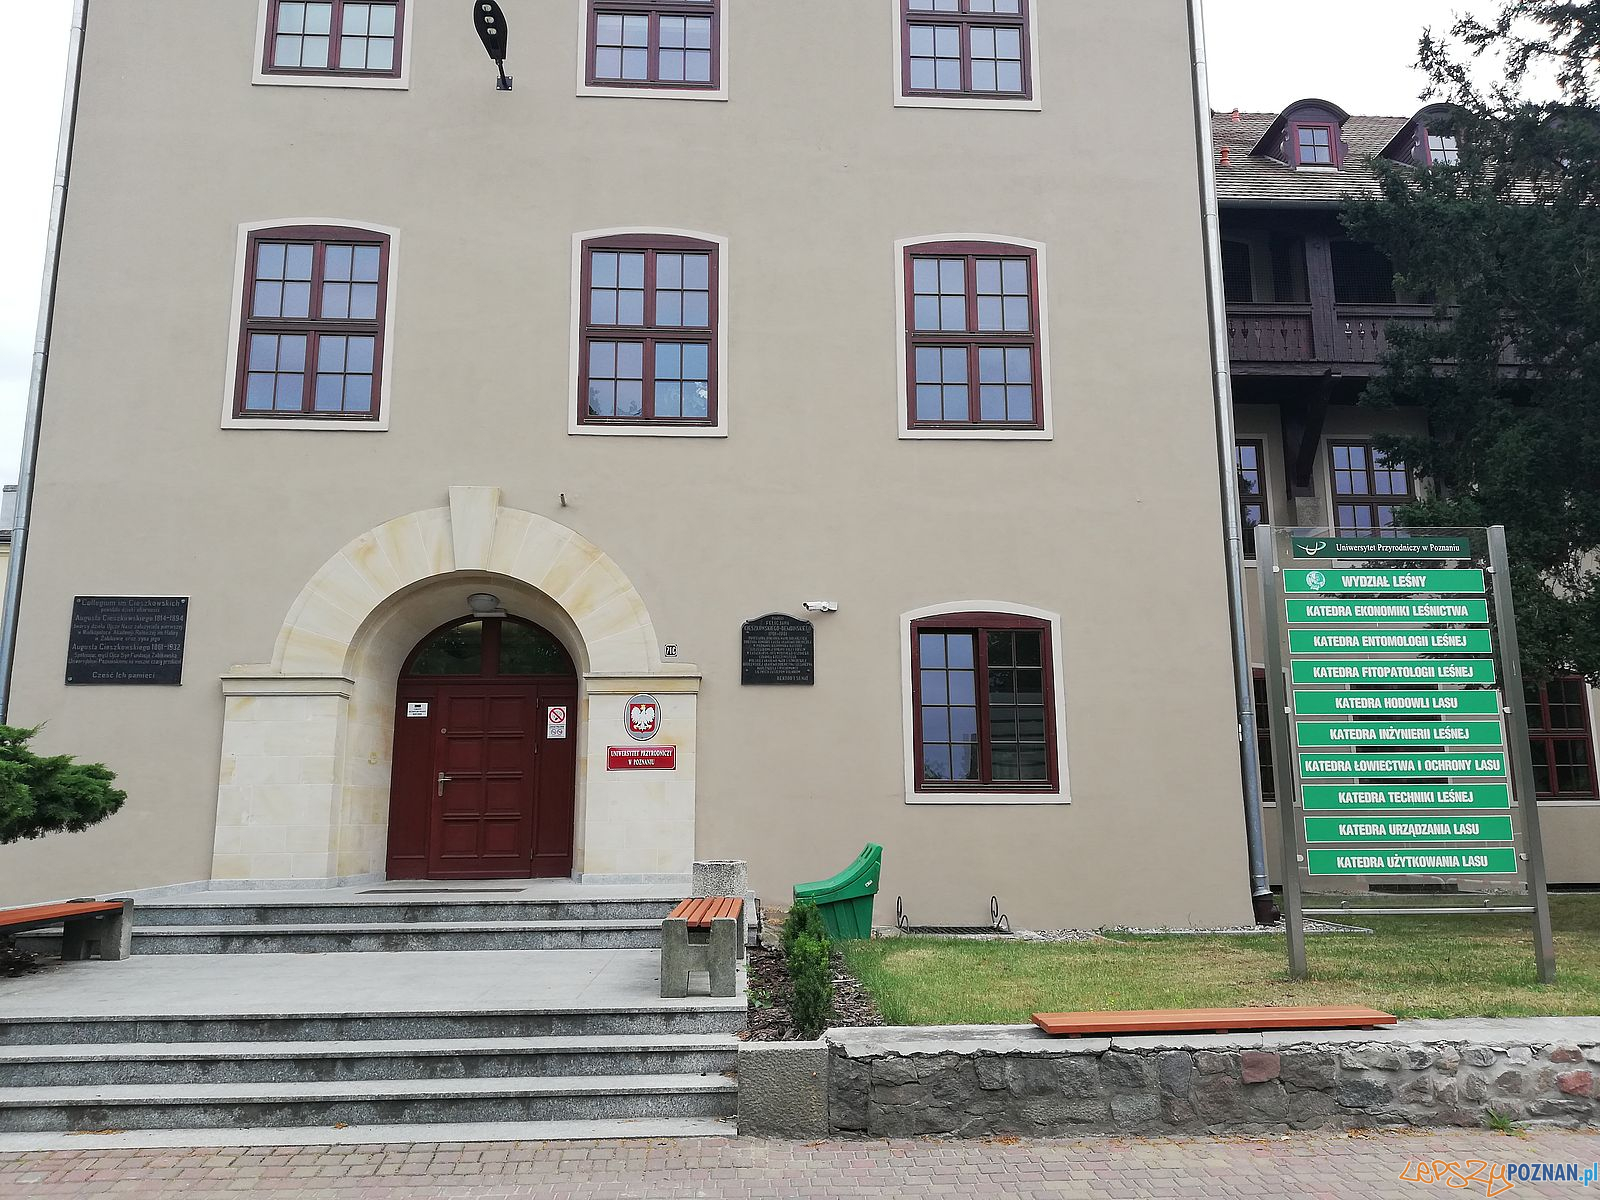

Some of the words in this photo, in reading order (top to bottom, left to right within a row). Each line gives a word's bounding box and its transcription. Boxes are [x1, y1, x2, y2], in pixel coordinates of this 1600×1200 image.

[1335, 543, 1376, 553] Uniwersytet
[1377, 543, 1420, 554] Przyrodniczy
[1429, 543, 1460, 552] Poznaniu
[1341, 575, 1390, 587] WYDZIAŁ
[1392, 573, 1427, 587] LEŚNY
[1306, 605, 1352, 617] KATEDRA
[1354, 605, 1410, 616] EKONOMIKI
[1412, 602, 1469, 616] LEŚNICTWA
[1313, 635, 1360, 647] KATEDRA
[1362, 635, 1429, 646] ENTOMOLOGII
[1431, 632, 1467, 646] LEŚNEJ
[1313, 666, 1360, 678] KATEDRA
[1362, 666, 1435, 677] FITOPATOLOGII
[1437, 663, 1474, 677] LEŚNEJ
[1335, 697, 1382, 709] KATEDRA
[1384, 697, 1430, 708] HODOWLI
[1432, 697, 1458, 708] LASU
[1329, 728, 1377, 740] KATEDRA
[1379, 725, 1431, 740] INŻYNIERII
[1433, 725, 1470, 739] LEŚNEJ
[1305, 760, 1351, 772] KATEDRA
[1354, 760, 1415, 771] ŁOWIECTWA
[1417, 760, 1422, 771] I
[1424, 759, 1472, 771] OCHRONY
[1474, 759, 1501, 771] LASU
[1338, 791, 1386, 803] KATEDRA
[1388, 791, 1435, 803] TECHNIKI
[1437, 788, 1474, 802] LEŚNEJ
[1338, 823, 1387, 836] KATEDRA
[1389, 823, 1452, 837] URZĄDZANIA
[1453, 823, 1480, 835] LASU
[1336, 856, 1385, 868] KATEDRA
[1387, 853, 1460, 868] UŻYTKOWANIA
[1462, 855, 1488, 867] LASU
